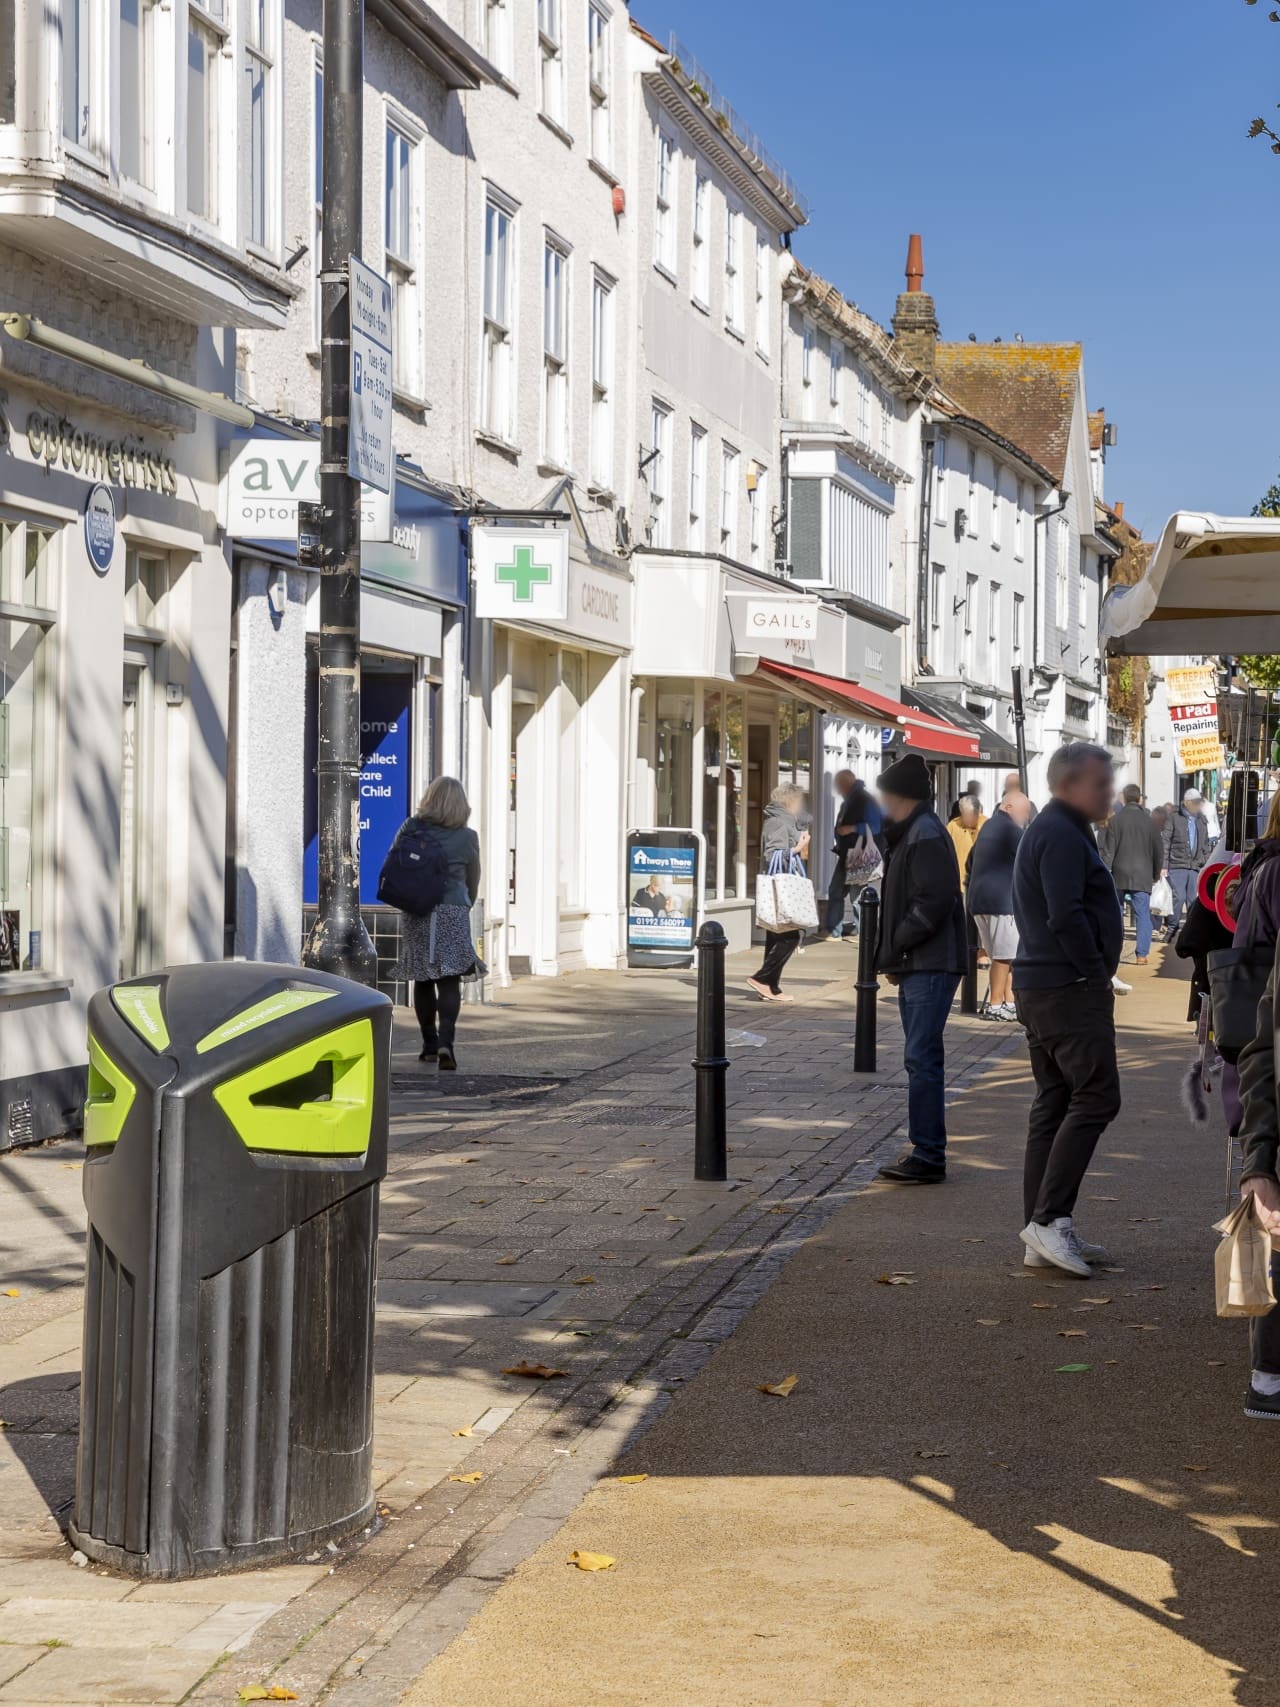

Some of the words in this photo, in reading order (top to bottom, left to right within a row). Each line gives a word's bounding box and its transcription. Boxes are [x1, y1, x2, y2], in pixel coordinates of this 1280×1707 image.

[27, 411, 177, 496] optometrists
[581, 581, 619, 622] CARDZONE
[753, 612, 811, 629] GAIL's
[1186, 704, 1211, 717] Pad
[1173, 719, 1219, 733] Repairing
[1181, 735, 1217, 748] iPhone
[1184, 756, 1220, 768] Repair
[361, 785, 392, 797] Child
[670, 858, 692, 866] There
